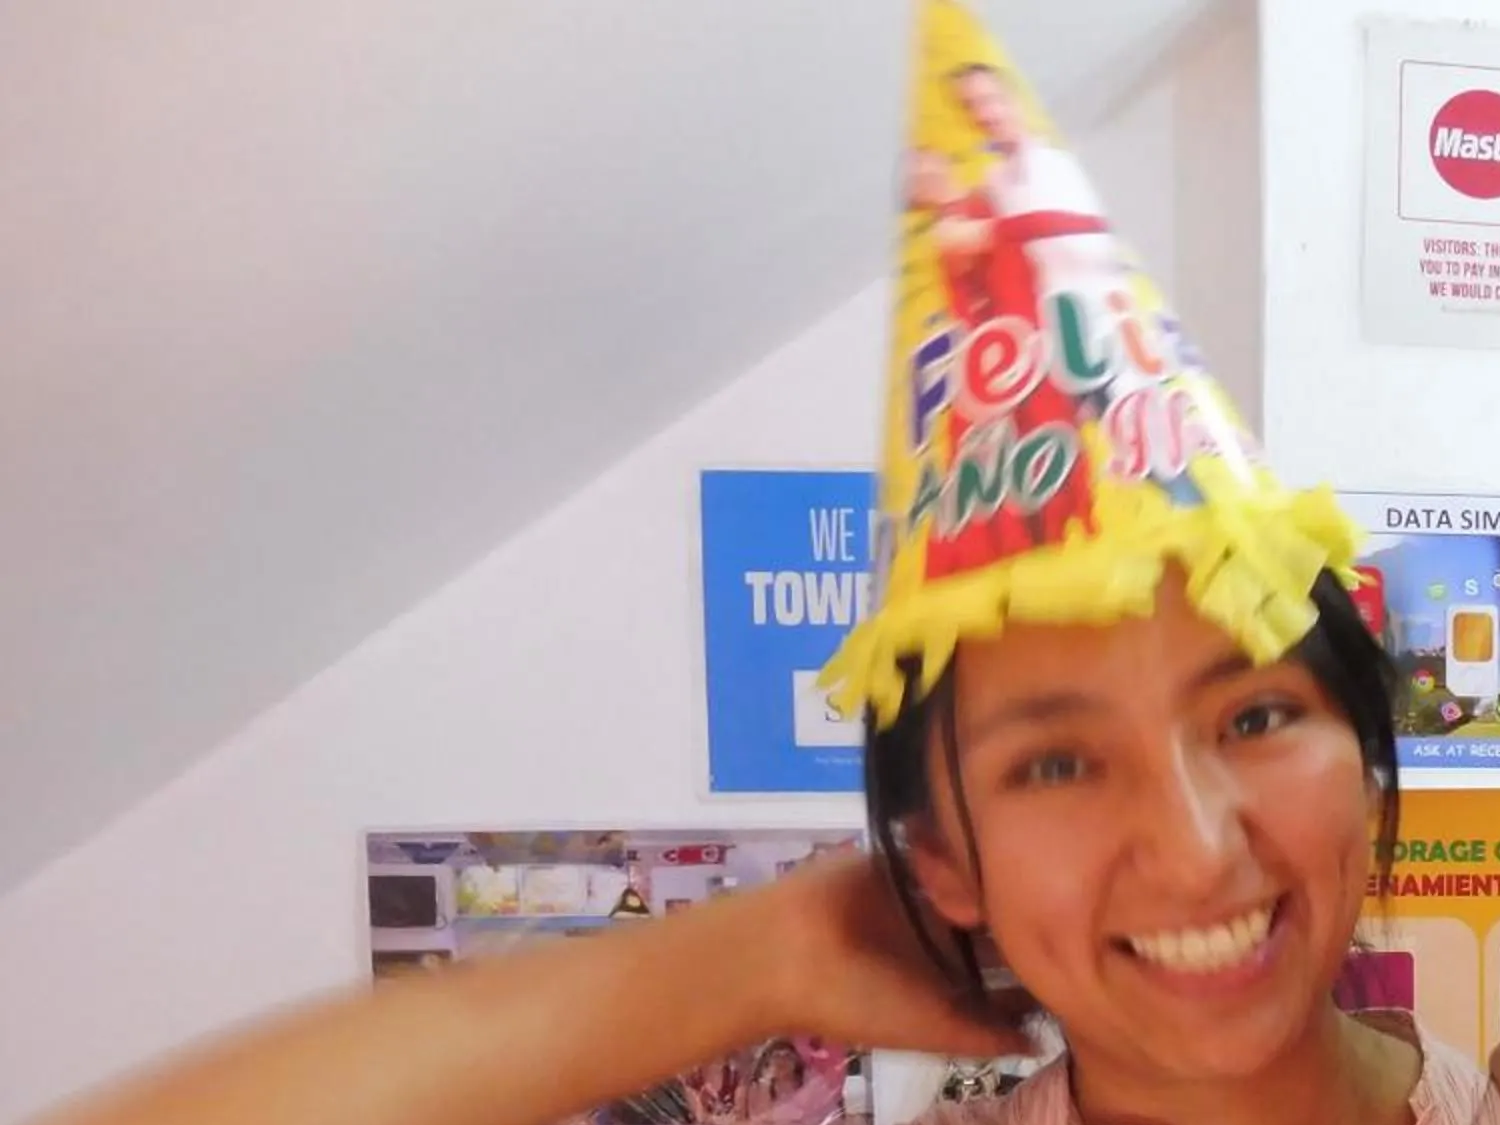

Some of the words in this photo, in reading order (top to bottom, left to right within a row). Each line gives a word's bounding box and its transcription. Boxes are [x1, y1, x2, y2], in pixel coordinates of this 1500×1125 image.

[1423, 238, 1481, 257] VISITORS:
[1420, 259, 1442, 275] YOU
[1446, 261, 1460, 276] TO
[1464, 261, 1484, 278] PAY
[1488, 264, 1500, 278] IN
[1429, 281, 1446, 297] WE
[1451, 283, 1491, 299] WOULD
[1386, 508, 1452, 529] DATA
[810, 508, 855, 561] WE
[1413, 744, 1441, 757] ASK
[1446, 744, 1463, 757] AT
